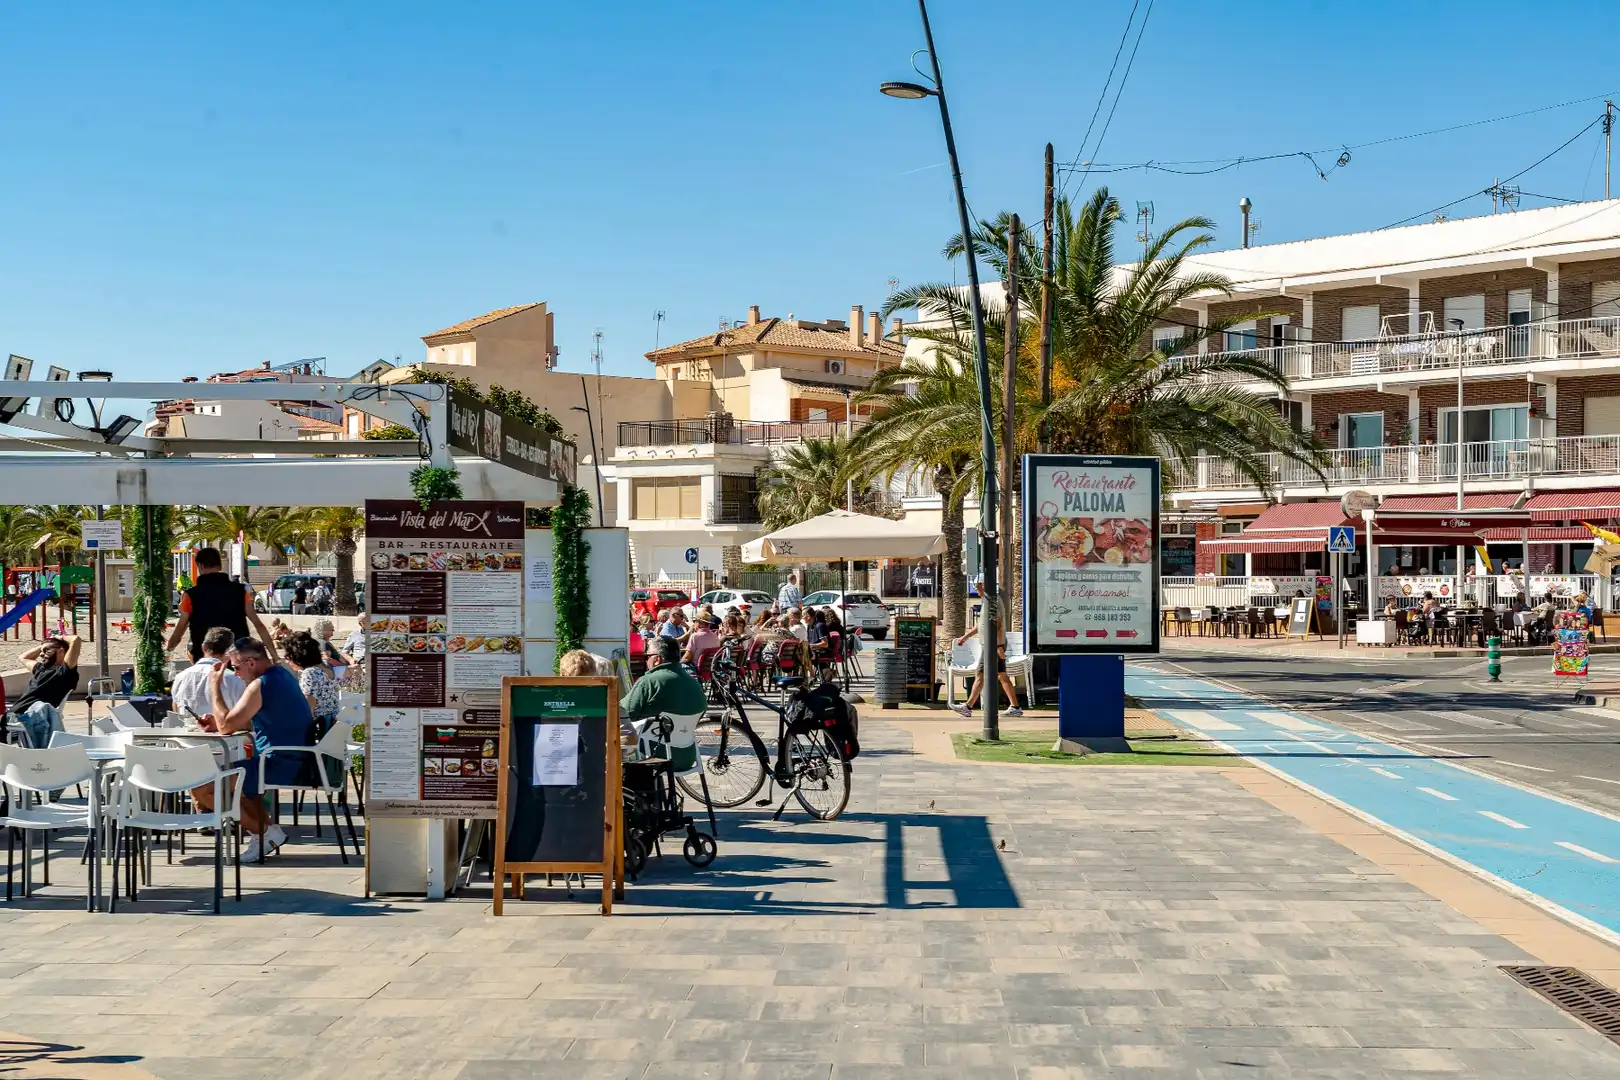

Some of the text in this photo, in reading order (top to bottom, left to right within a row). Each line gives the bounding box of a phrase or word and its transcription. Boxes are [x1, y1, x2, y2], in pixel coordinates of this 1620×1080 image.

[1052, 470, 1136, 496] Restaurante
[1063, 492, 1126, 513] PALOMA
[400, 510, 475, 529] Vista del Mar
[378, 540, 404, 549] BAR
[420, 541, 514, 550] RESTAURANTE
[915, 577, 933, 585] AMSTEL
[1082, 573, 1098, 581] cenas
[1099, 573, 1111, 582] para
[1062, 585, 1131, 599] ¡Te Esperamos!
